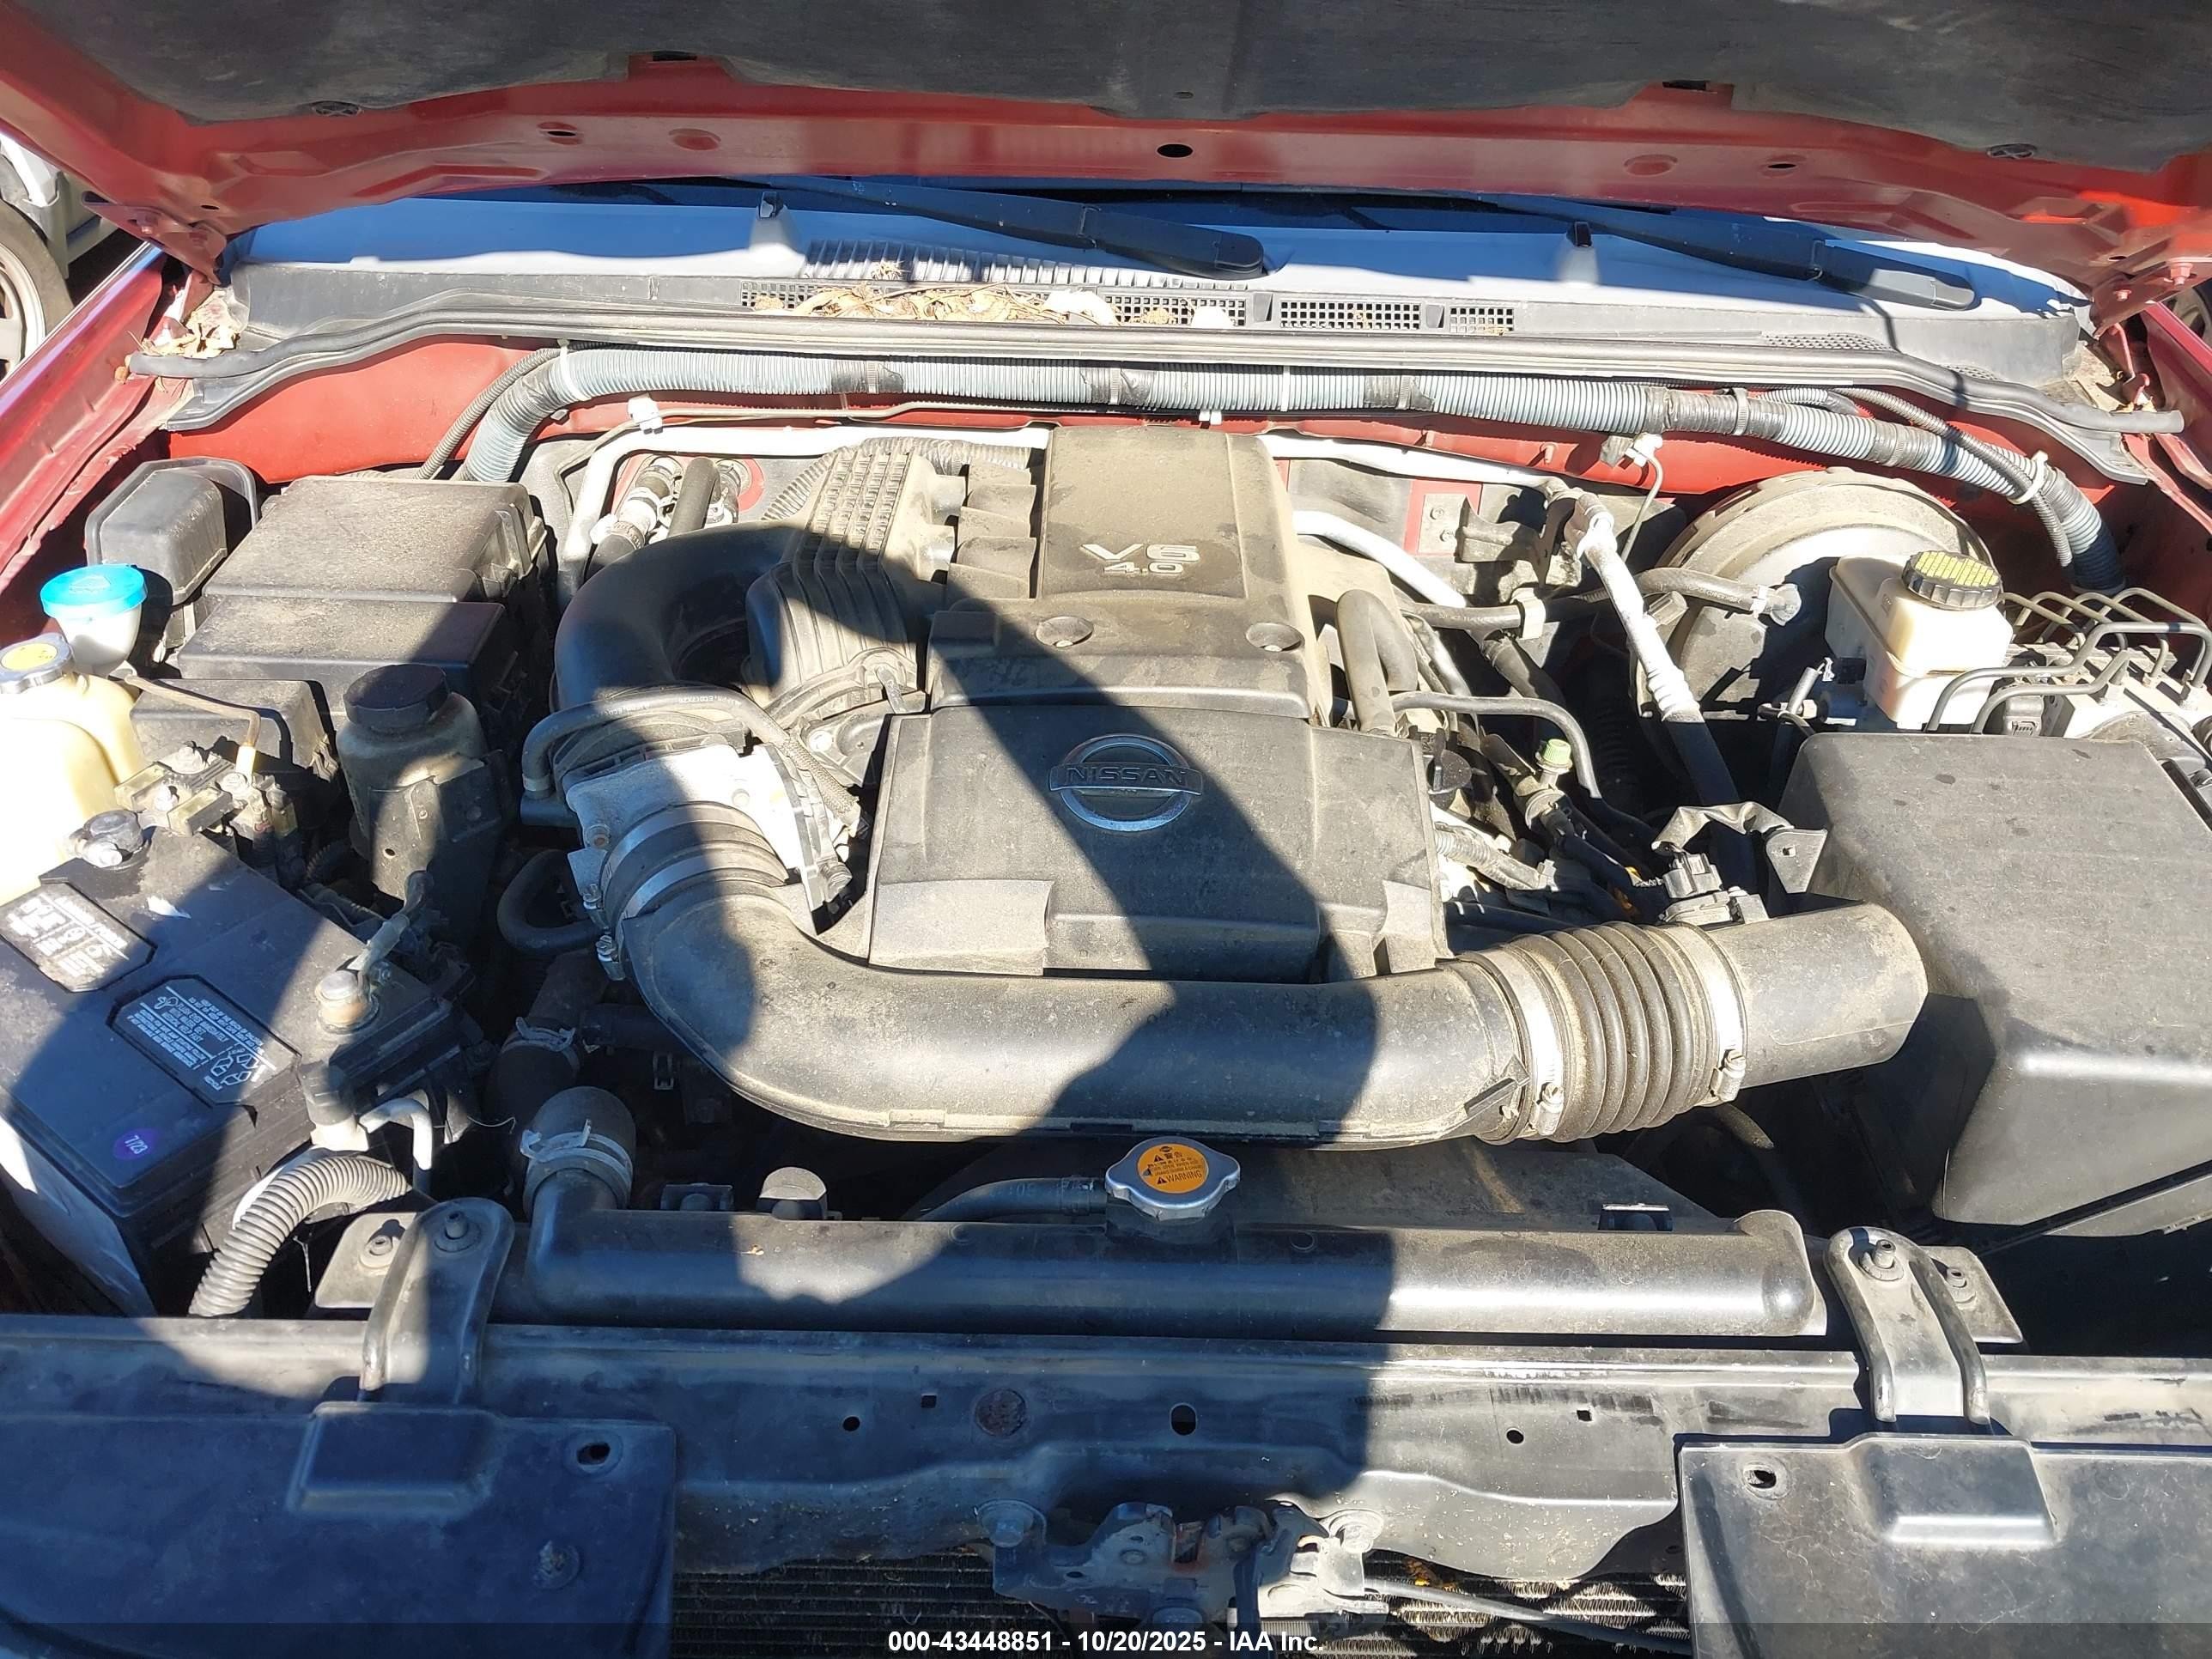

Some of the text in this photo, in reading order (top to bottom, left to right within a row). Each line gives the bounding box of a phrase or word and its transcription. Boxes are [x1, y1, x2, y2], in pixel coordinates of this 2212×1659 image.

[1079, 544, 1200, 563] V6
[1103, 562, 1183, 576] 4.0
[1066, 767, 1187, 786] NISSAN
[125, 1134, 148, 1154] 7/23
[1166, 1170, 1202, 1182] WARNING
